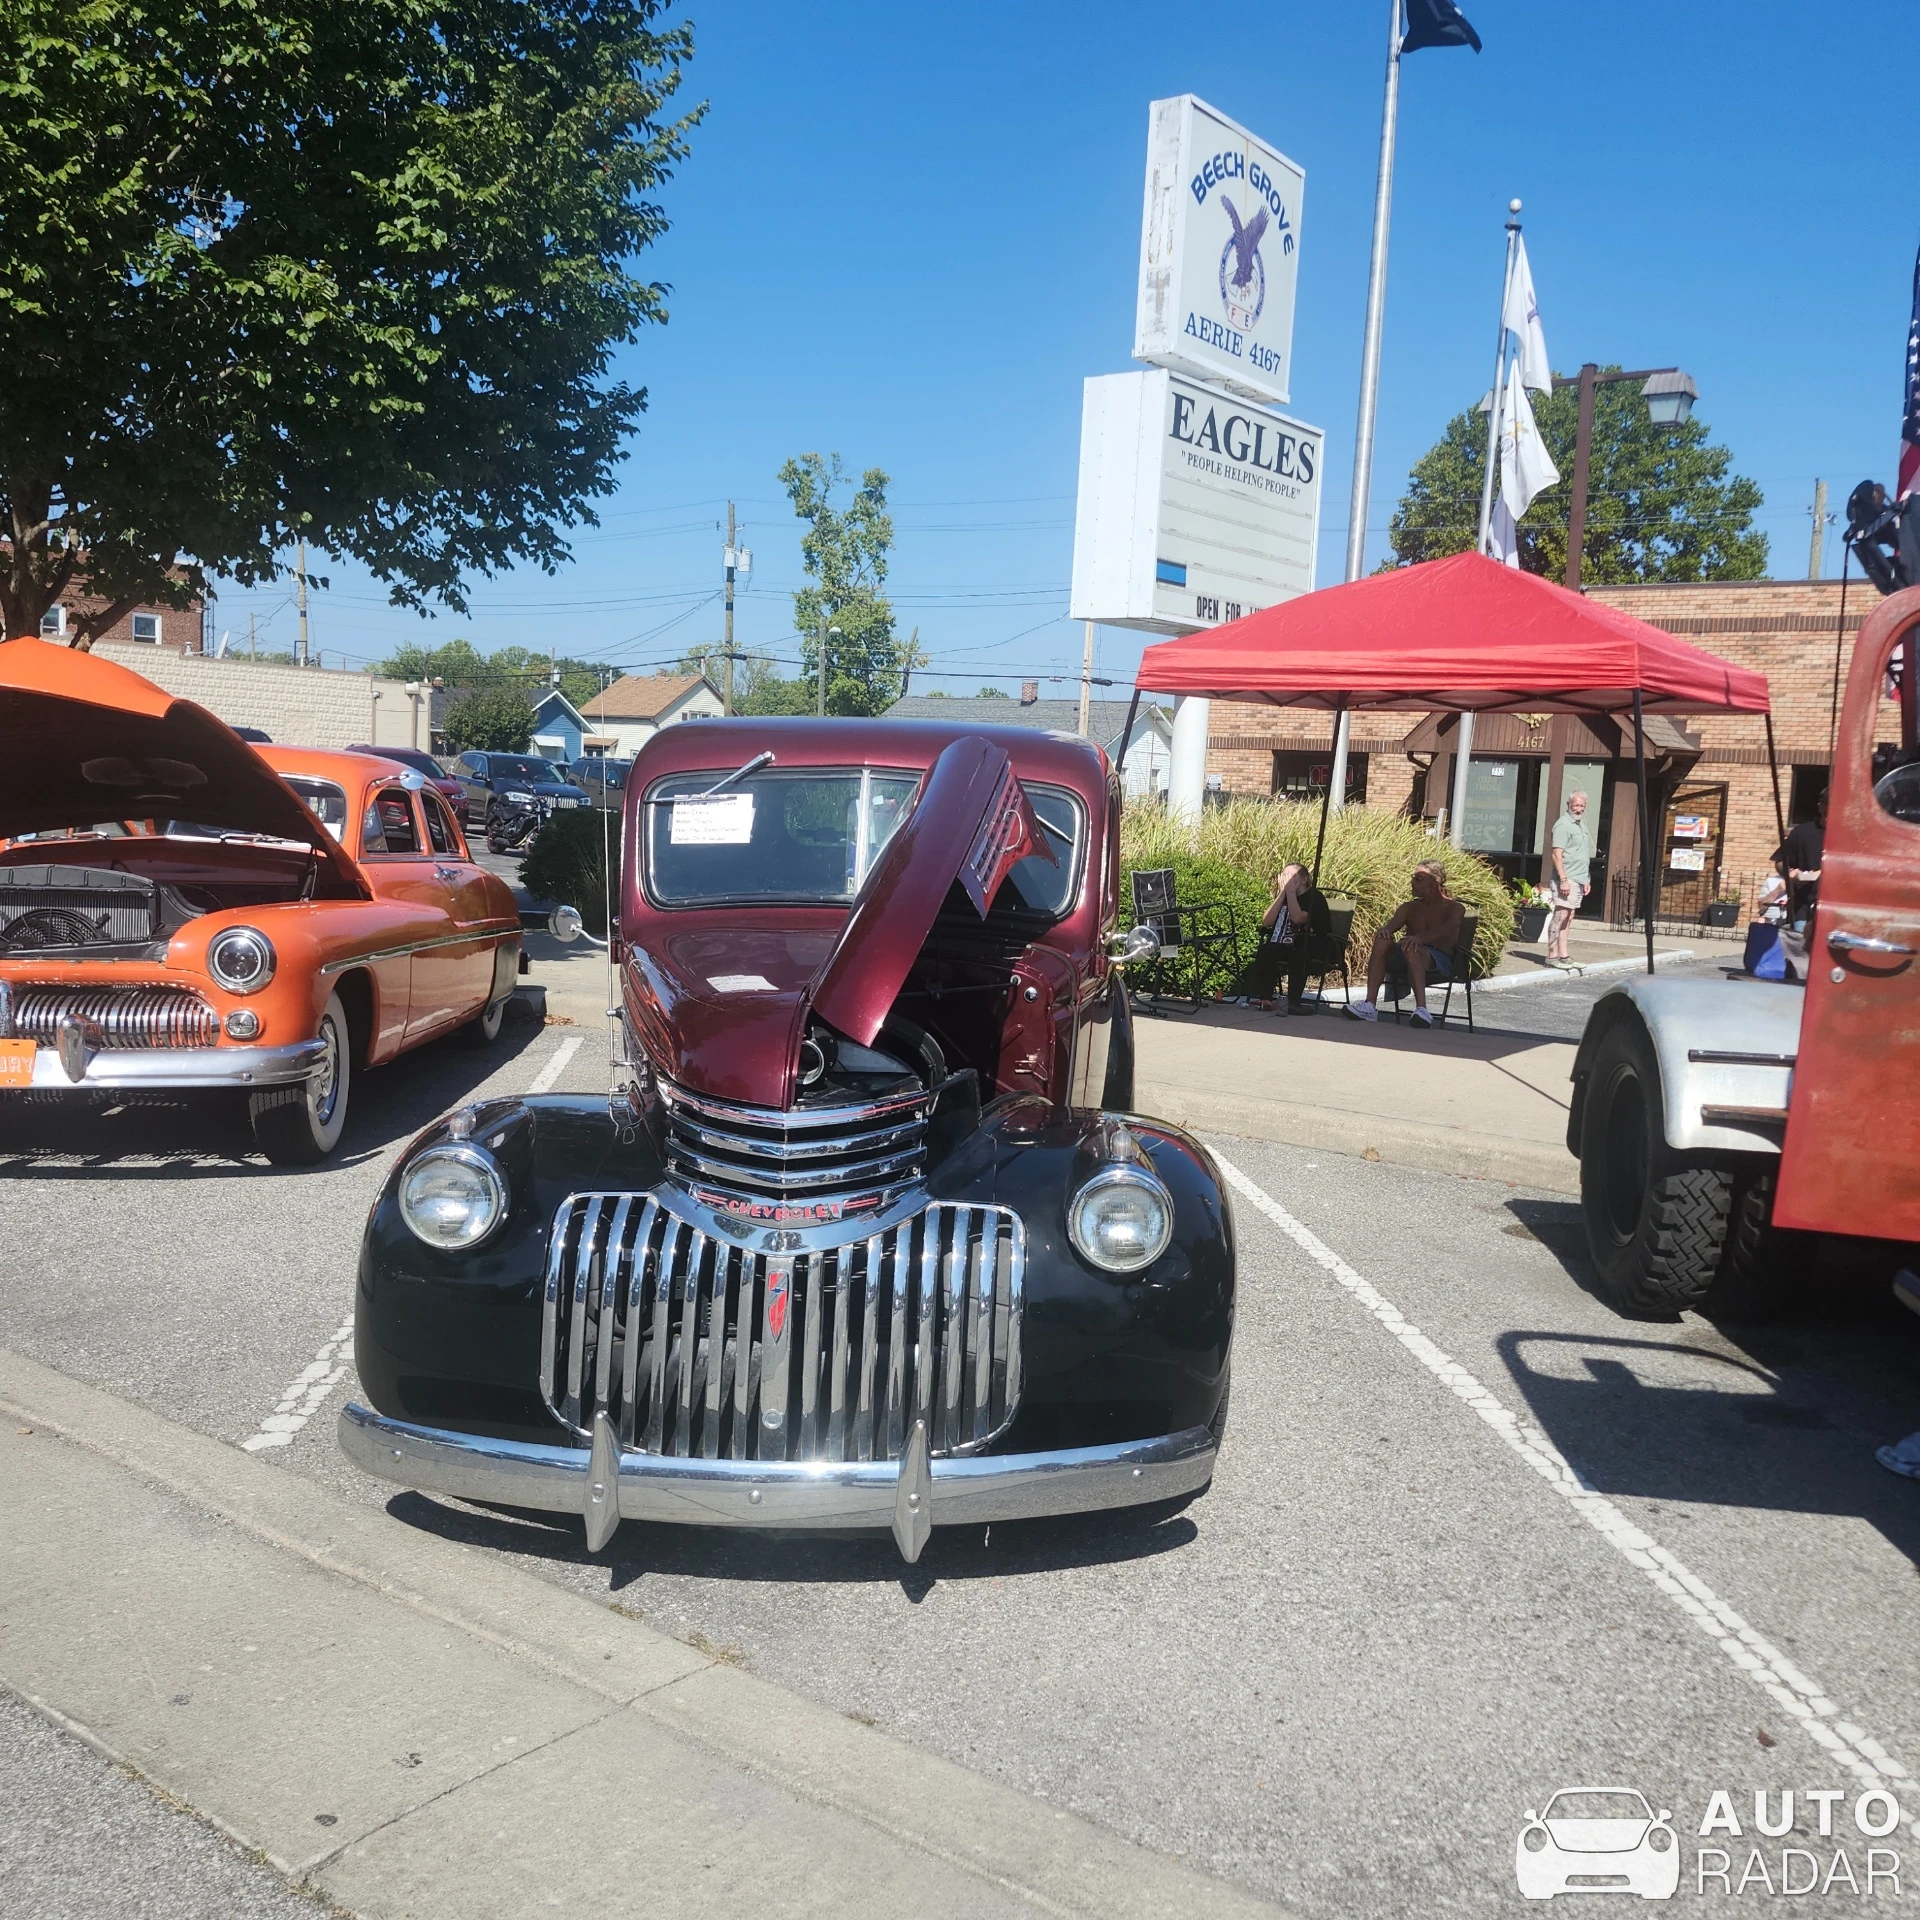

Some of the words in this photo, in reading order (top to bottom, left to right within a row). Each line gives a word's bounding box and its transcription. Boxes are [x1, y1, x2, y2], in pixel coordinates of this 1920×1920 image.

[1190, 151, 1245, 206] BEECH
[1249, 161, 1294, 256] GROVE
[1184, 312, 1243, 358] AERIE
[1249, 342, 1281, 375] 4167
[1168, 391, 1316, 485] EAGLES
[1224, 464, 1264, 489] HELPING
[1265, 478, 1301, 500] PEOPLE"
[1196, 595, 1219, 621] OPEN
[1225, 602, 1241, 623] FOR
[1517, 736, 1546, 748] 4167
[728, 1200, 840, 1221] CHEVROLET
